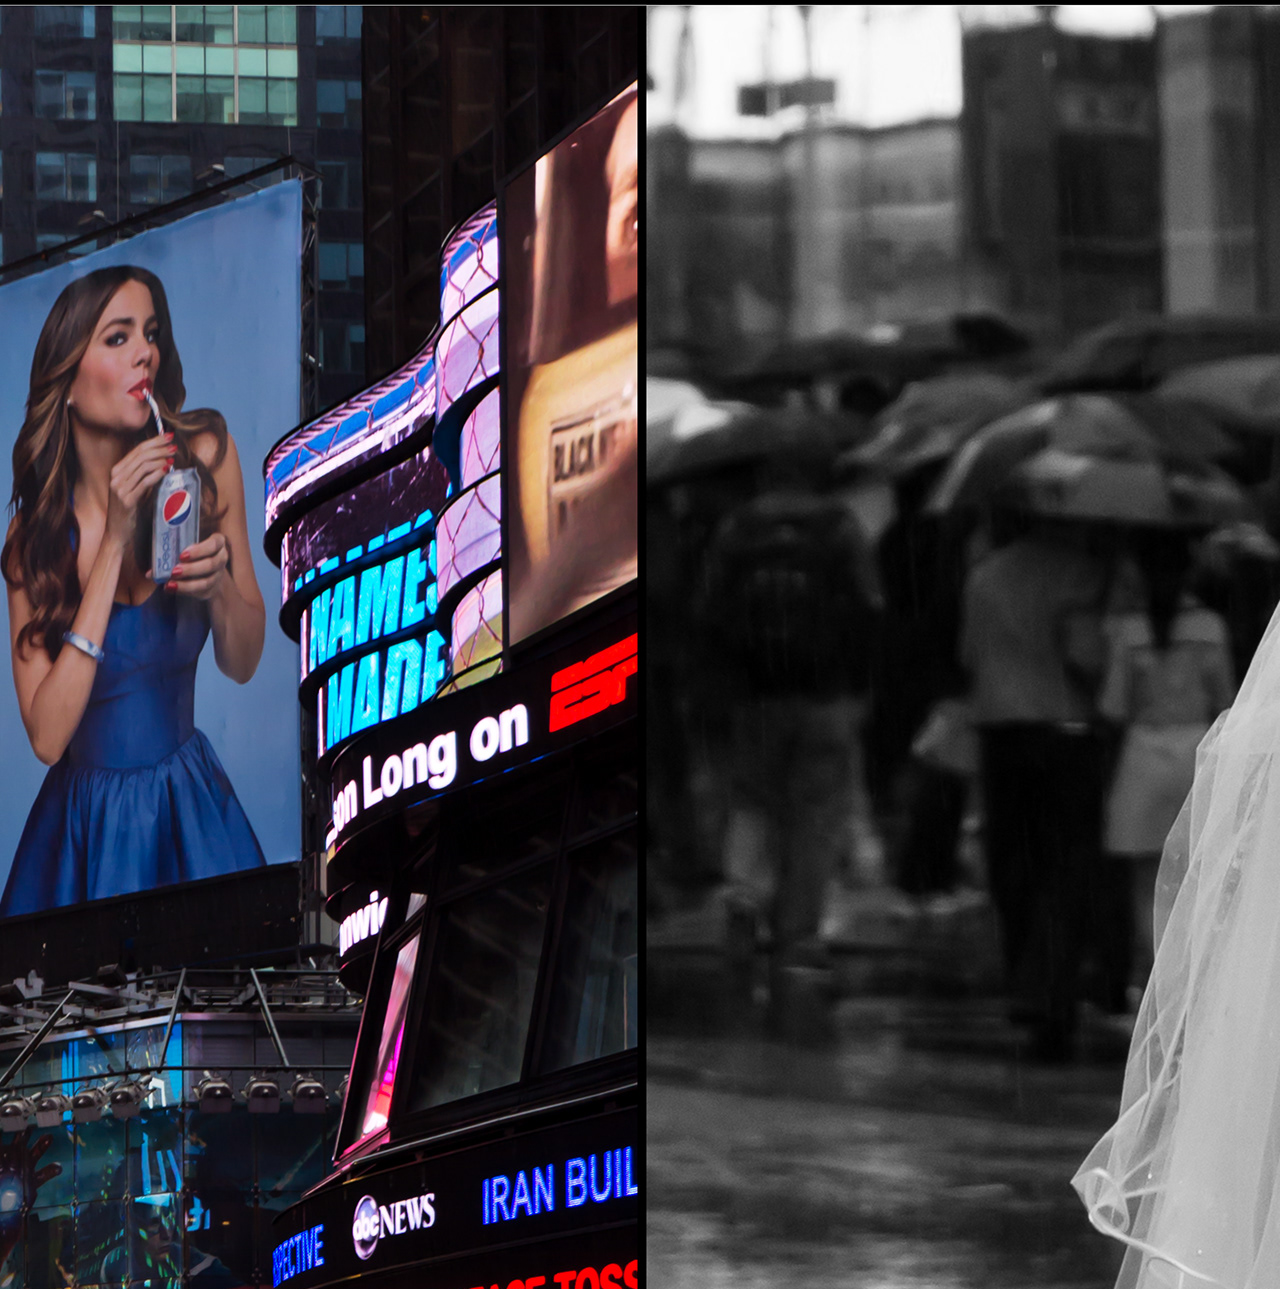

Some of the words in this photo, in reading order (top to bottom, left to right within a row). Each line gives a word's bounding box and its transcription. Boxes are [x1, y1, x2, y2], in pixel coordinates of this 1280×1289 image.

[363, 730, 457, 810] Long
[470, 703, 529, 762] on
[379, 1192, 436, 1239] NEWS
[482, 1163, 555, 1225] IRAN
